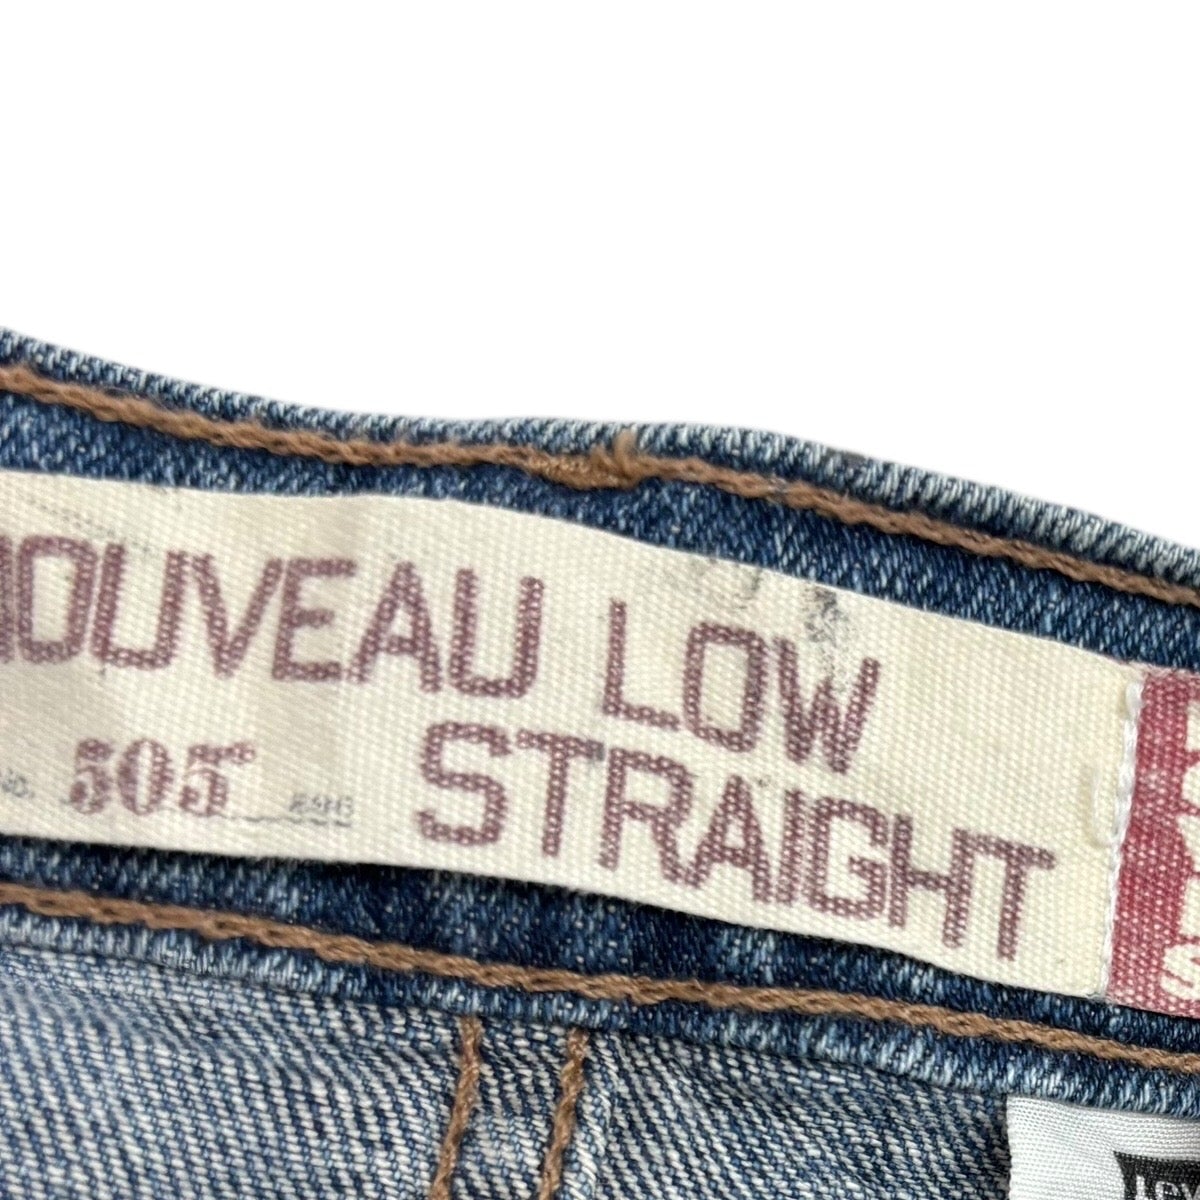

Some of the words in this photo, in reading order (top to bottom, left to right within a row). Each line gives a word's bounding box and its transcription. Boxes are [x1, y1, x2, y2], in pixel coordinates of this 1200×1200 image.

[601, 597, 880, 775] LOW
[69, 738, 256, 815] 505
[416, 719, 1057, 961] STRAIGHT
